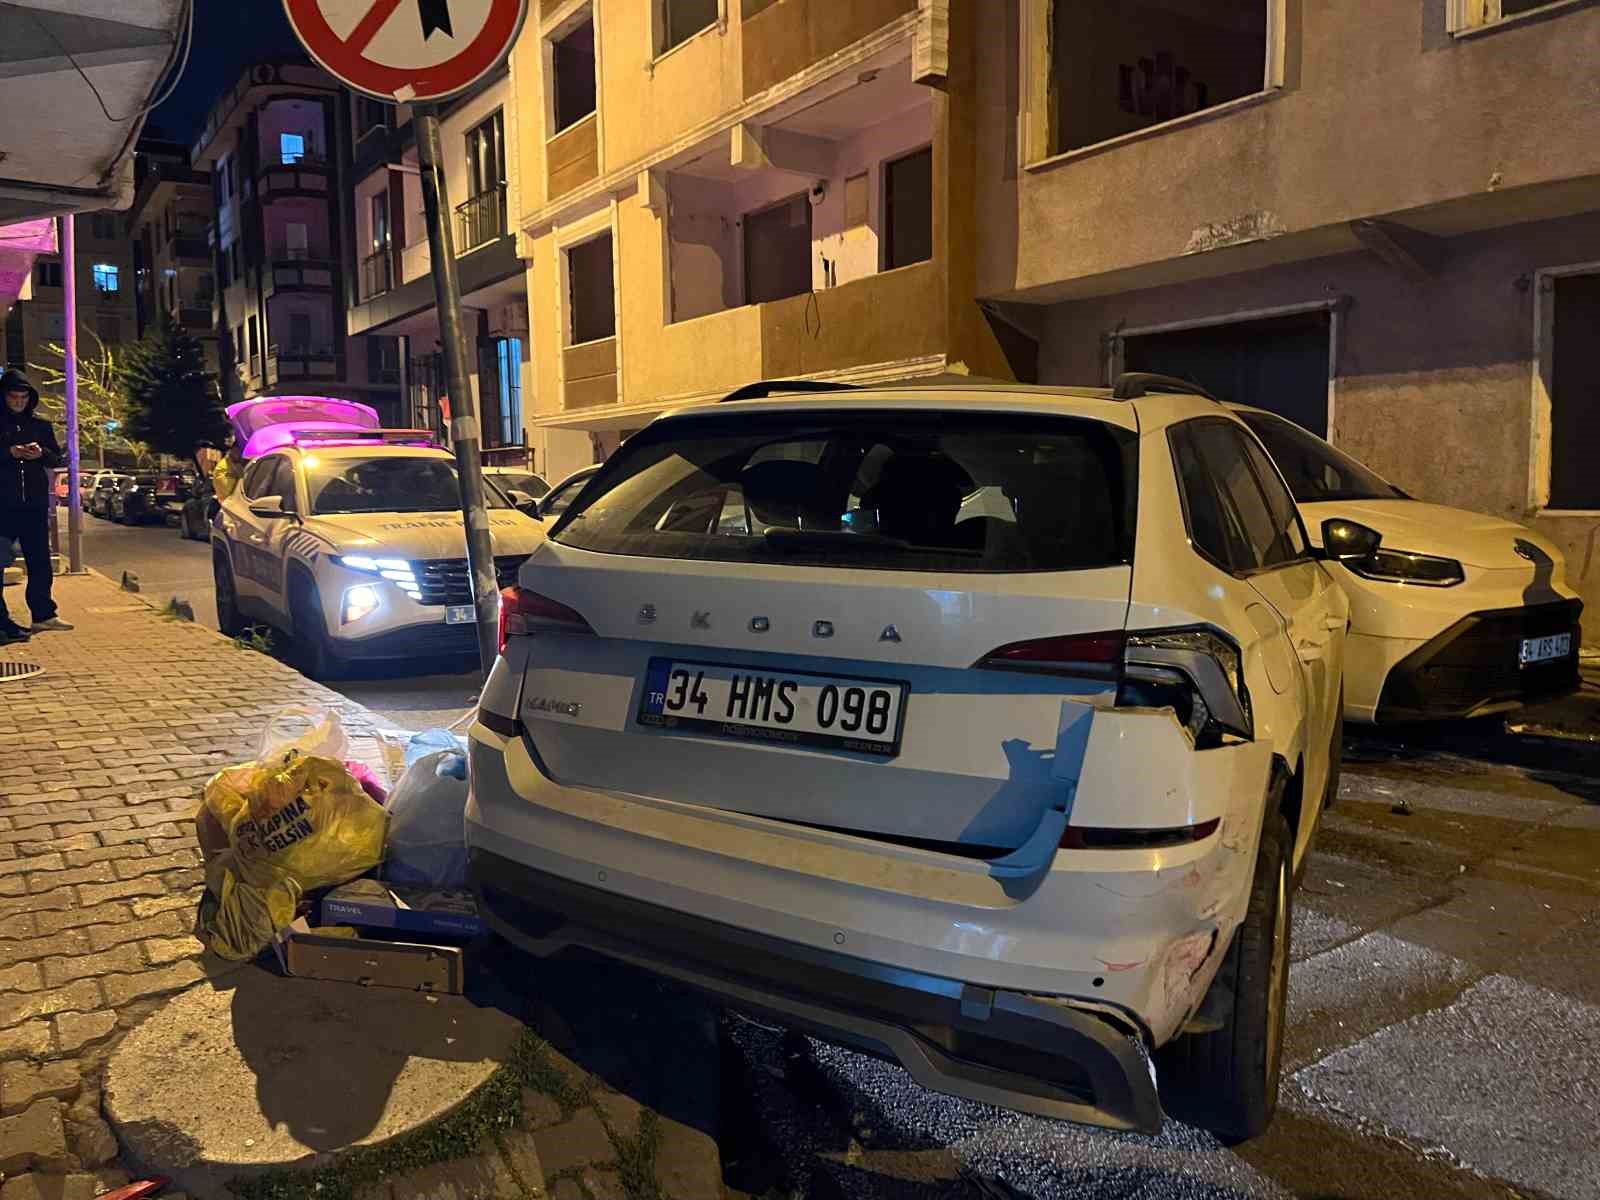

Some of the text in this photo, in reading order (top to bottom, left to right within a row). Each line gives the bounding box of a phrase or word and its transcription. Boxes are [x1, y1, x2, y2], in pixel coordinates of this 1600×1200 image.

[650, 692, 664, 705] TR
[667, 670, 708, 714] 34
[726, 675, 798, 723] HMS
[817, 685, 891, 735] 098
[256, 797, 311, 838] KAPINA
[328, 903, 363, 915] TRAVEL
